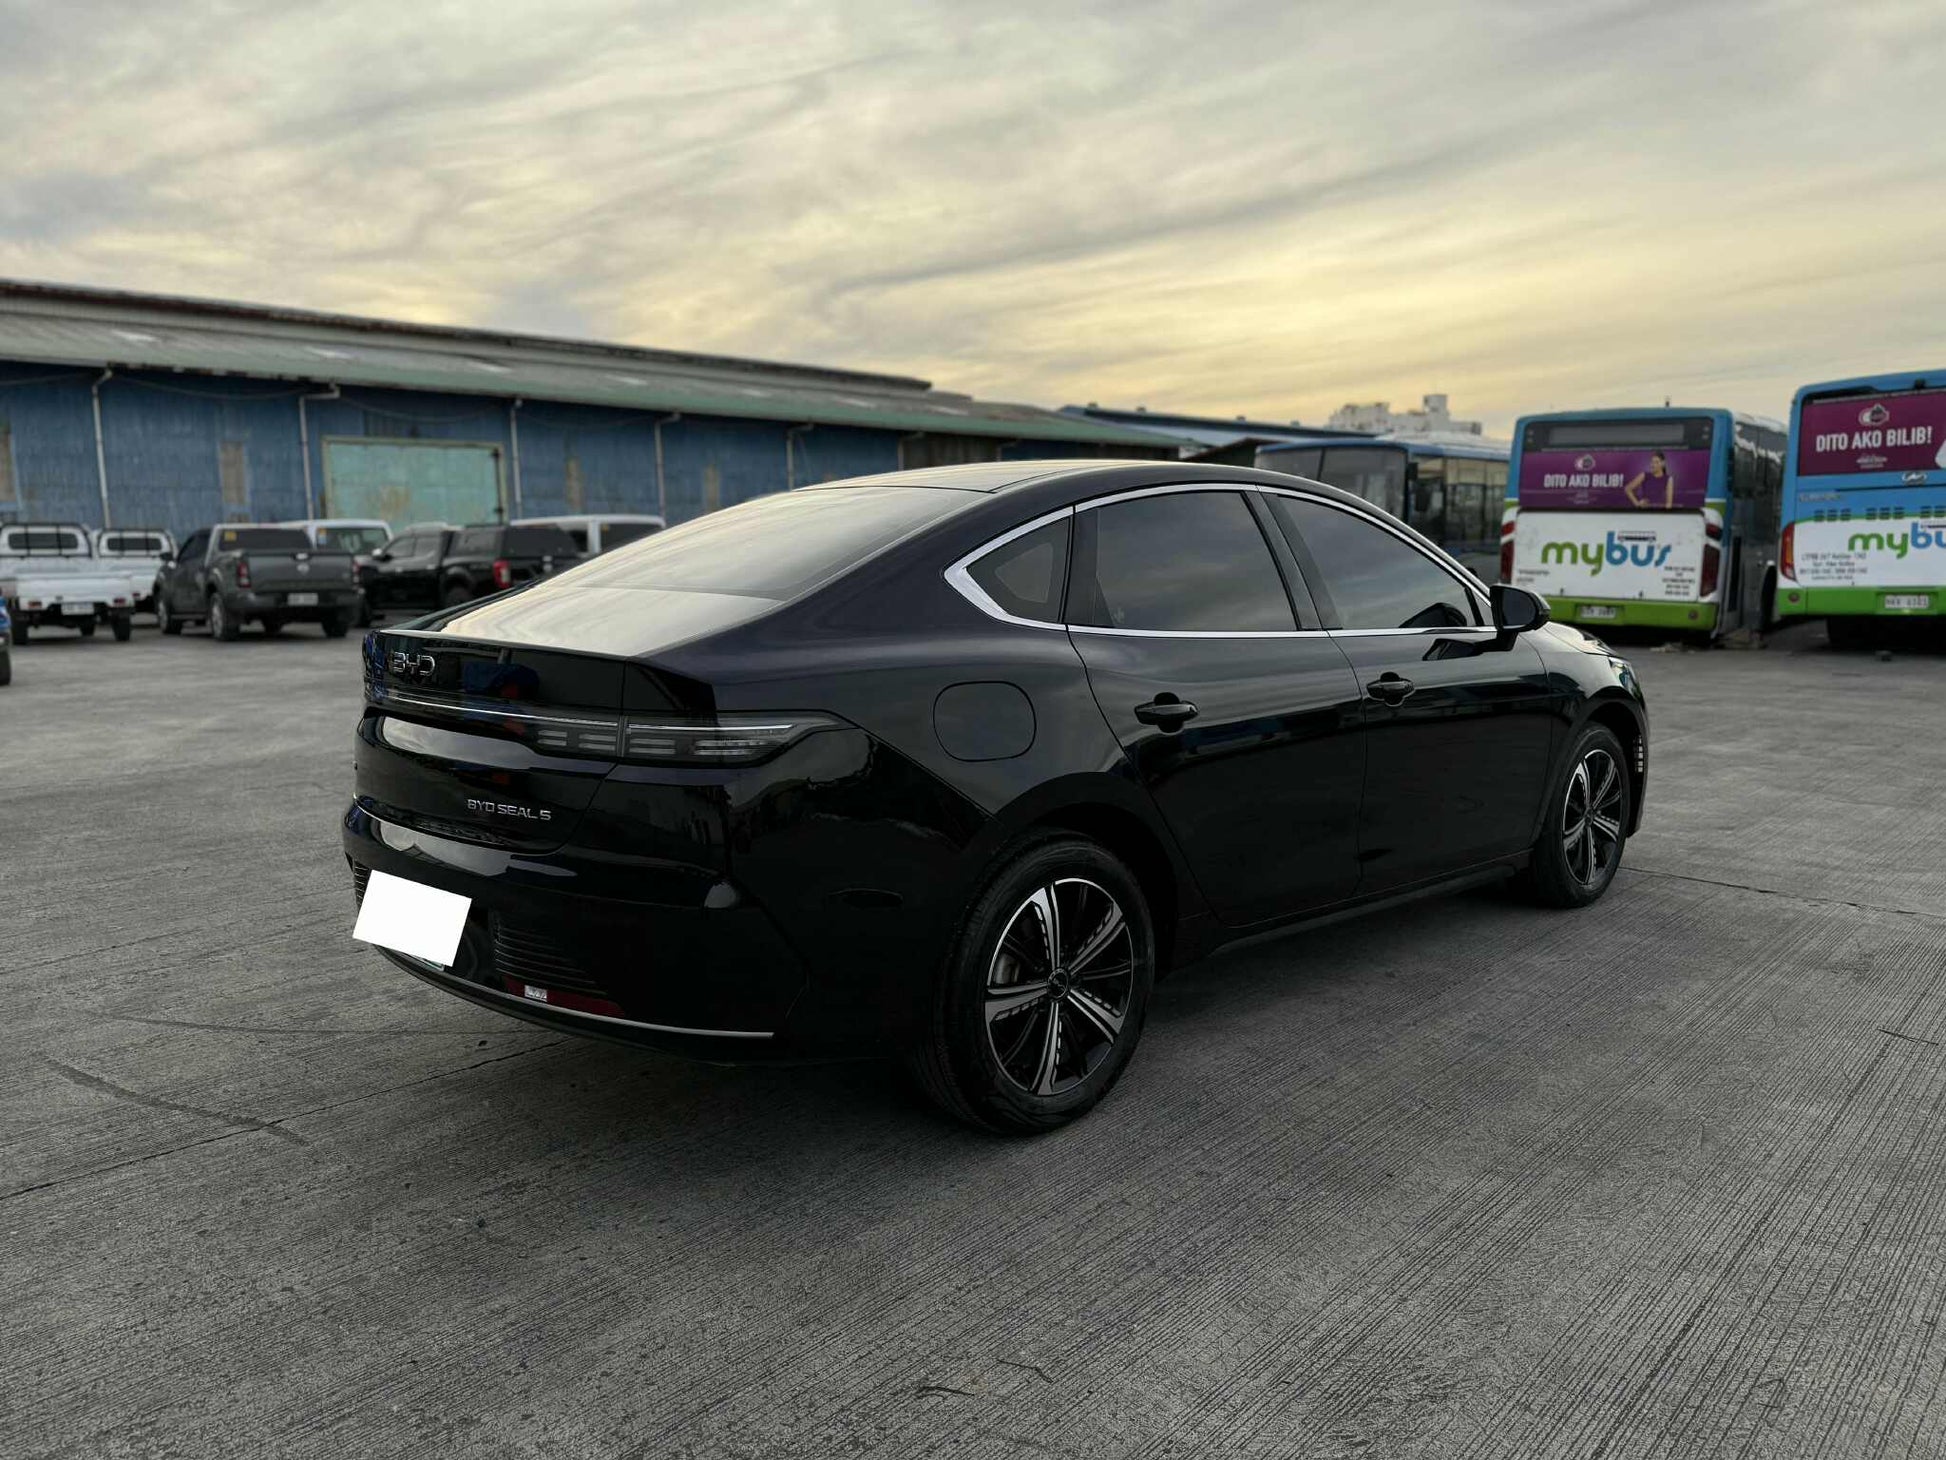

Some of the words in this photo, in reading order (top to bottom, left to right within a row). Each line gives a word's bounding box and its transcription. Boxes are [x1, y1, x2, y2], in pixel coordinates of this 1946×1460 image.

[1816, 433, 1848, 452] DITO
[1852, 430, 1882, 449] AKO
[1886, 426, 1933, 447] BILIB!
[1544, 474, 1567, 488] DITO
[1568, 474, 1590, 487] AKO
[1592, 474, 1624, 487] BILIB!
[1541, 531, 1672, 577] mybus
[392, 651, 436, 677] BYD
[467, 799, 495, 813] BYD
[498, 804, 538, 820] SEAL
[540, 810, 552, 821] 5
